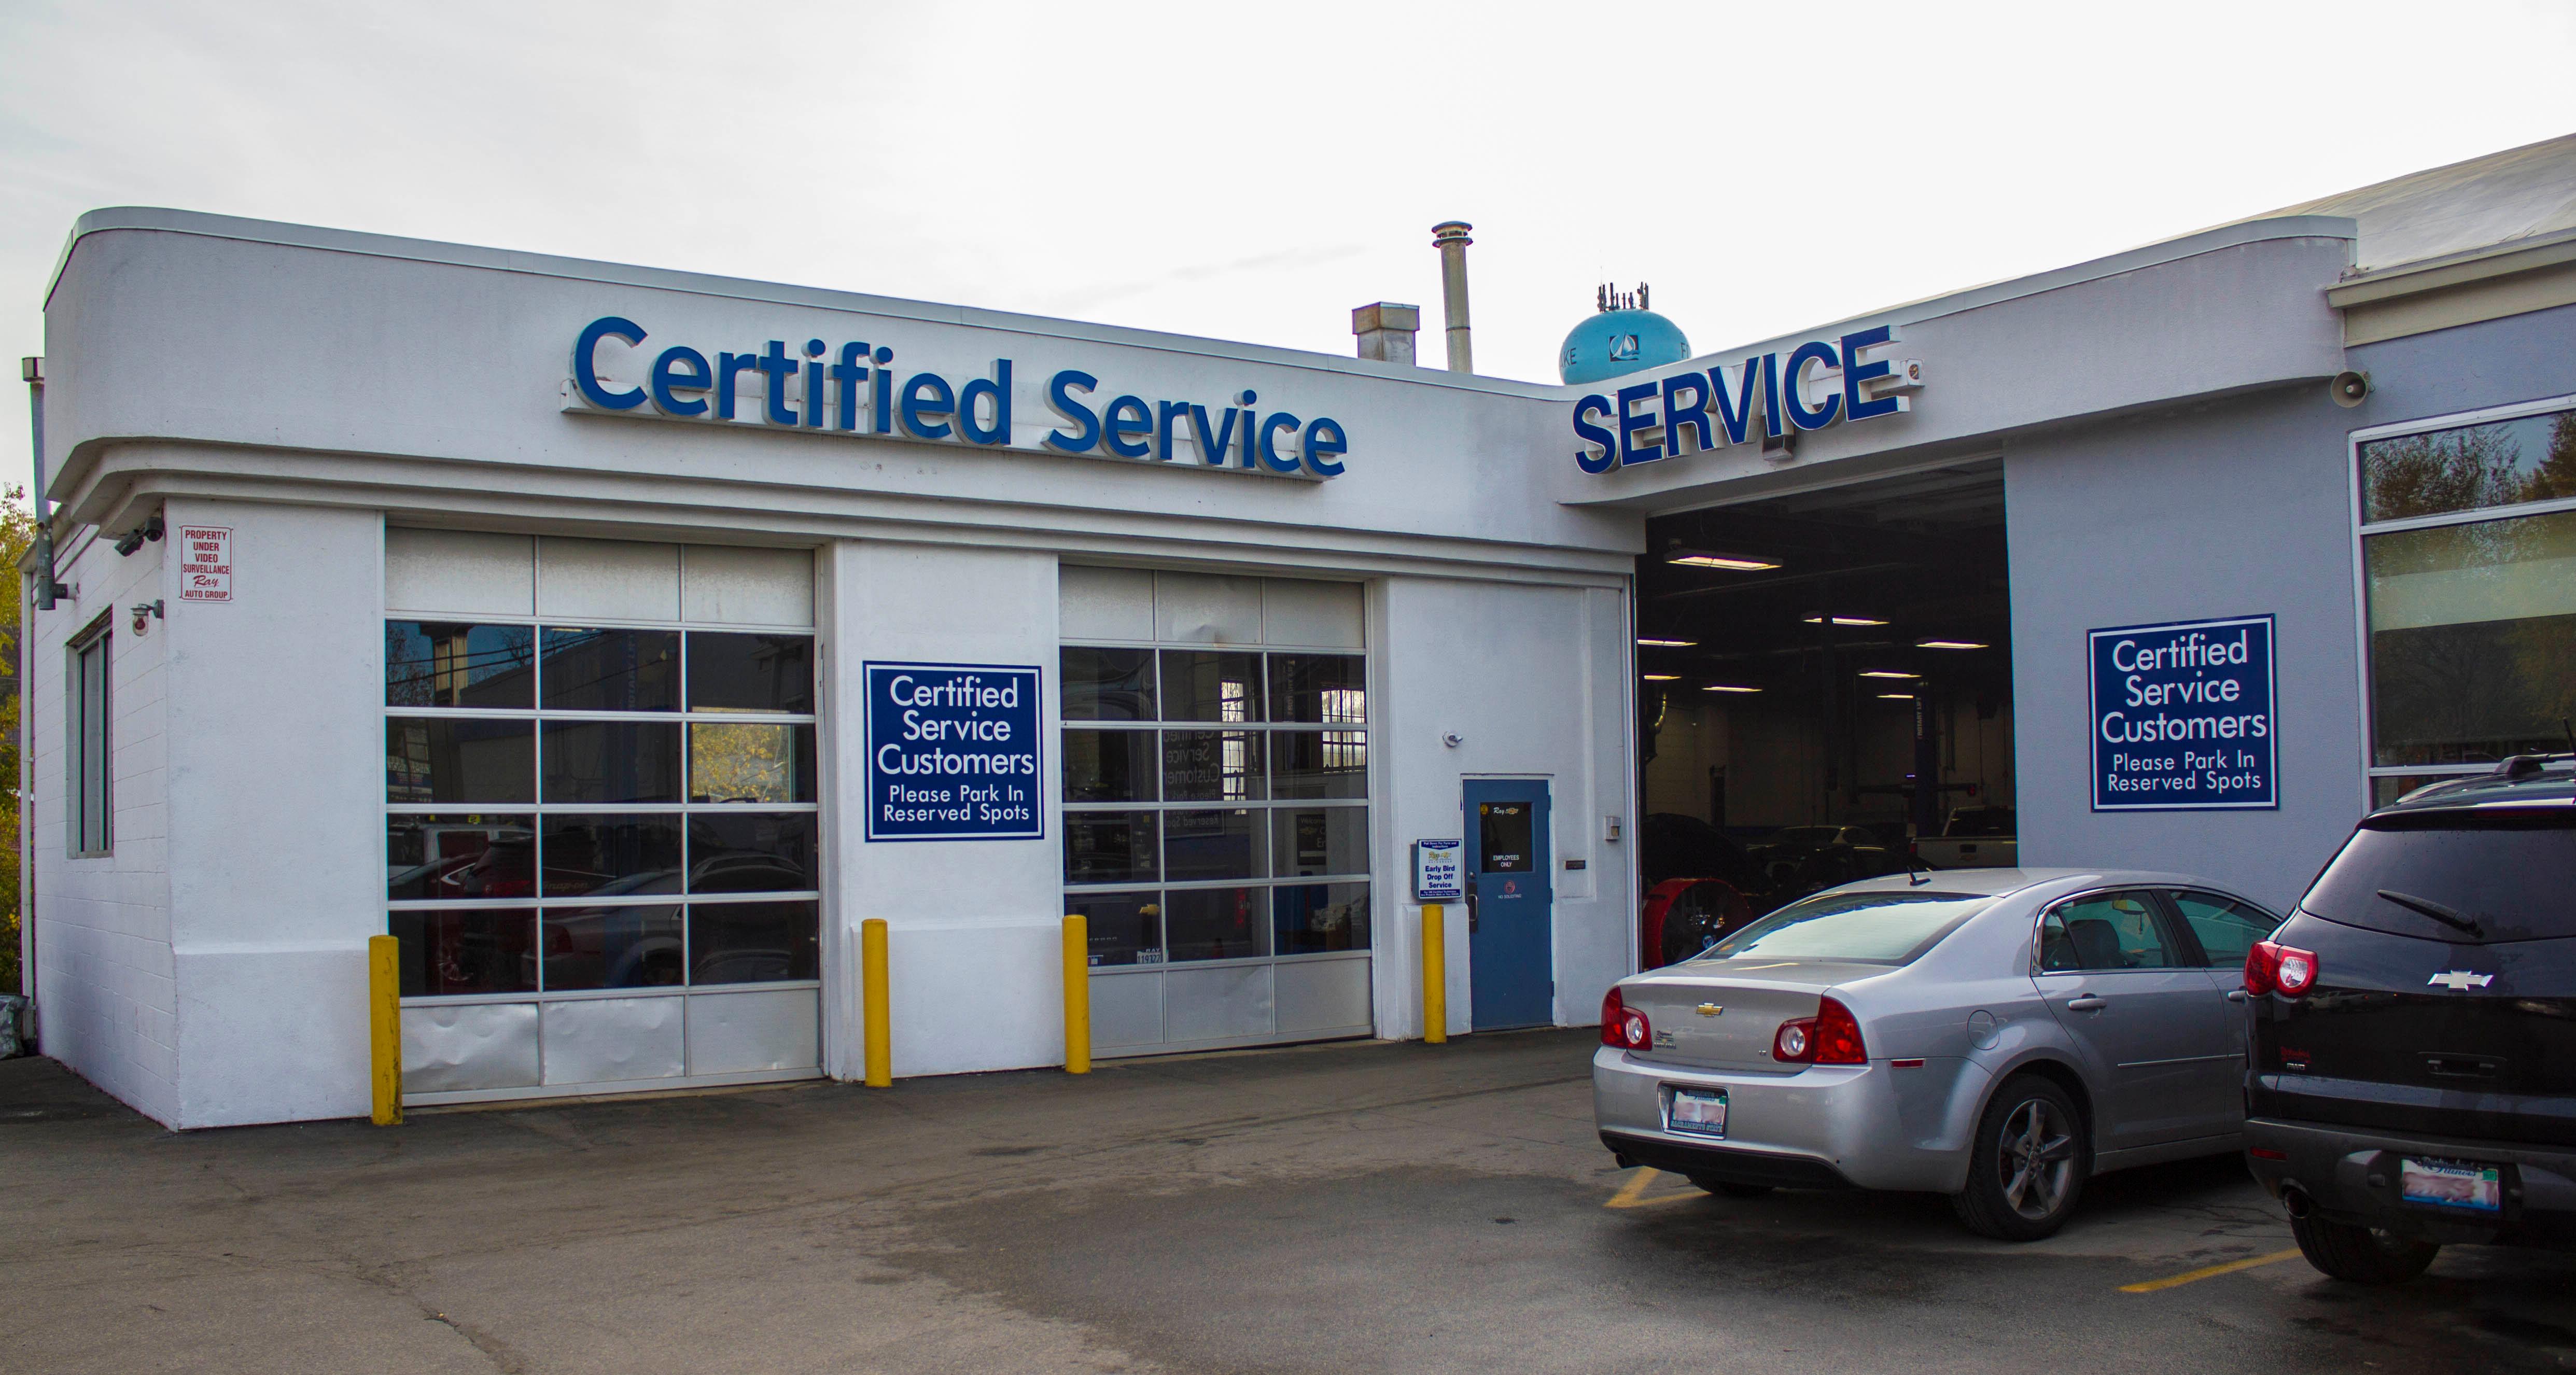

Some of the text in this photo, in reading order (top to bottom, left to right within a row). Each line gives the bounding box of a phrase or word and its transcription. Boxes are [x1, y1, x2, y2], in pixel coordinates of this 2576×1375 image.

[570, 317, 1348, 478] Certified Service
[1572, 325, 1900, 474] SERVICE
[185, 529, 227, 540] PROPERTY
[193, 541, 219, 551] UNDER
[183, 564, 230, 574] SURVEILLANCE
[195, 553, 218, 563] VIDEO
[193, 574, 219, 588] Ray
[185, 590, 228, 599] AUTO GROUP
[2112, 628, 2248, 672] Certified
[890, 675, 1018, 708] Certified
[2125, 670, 2240, 707] Service
[903, 709, 1011, 741] Service
[2101, 711, 2267, 743] Customers
[877, 743, 1034, 775] Customers
[2113, 749, 2255, 771] Please Park In
[889, 783, 1024, 803] Please Park In
[2108, 770, 2261, 794] Reserved Spots
[884, 803, 1030, 825] Reserved Spots
[1493, 807, 1505, 816] Ray
